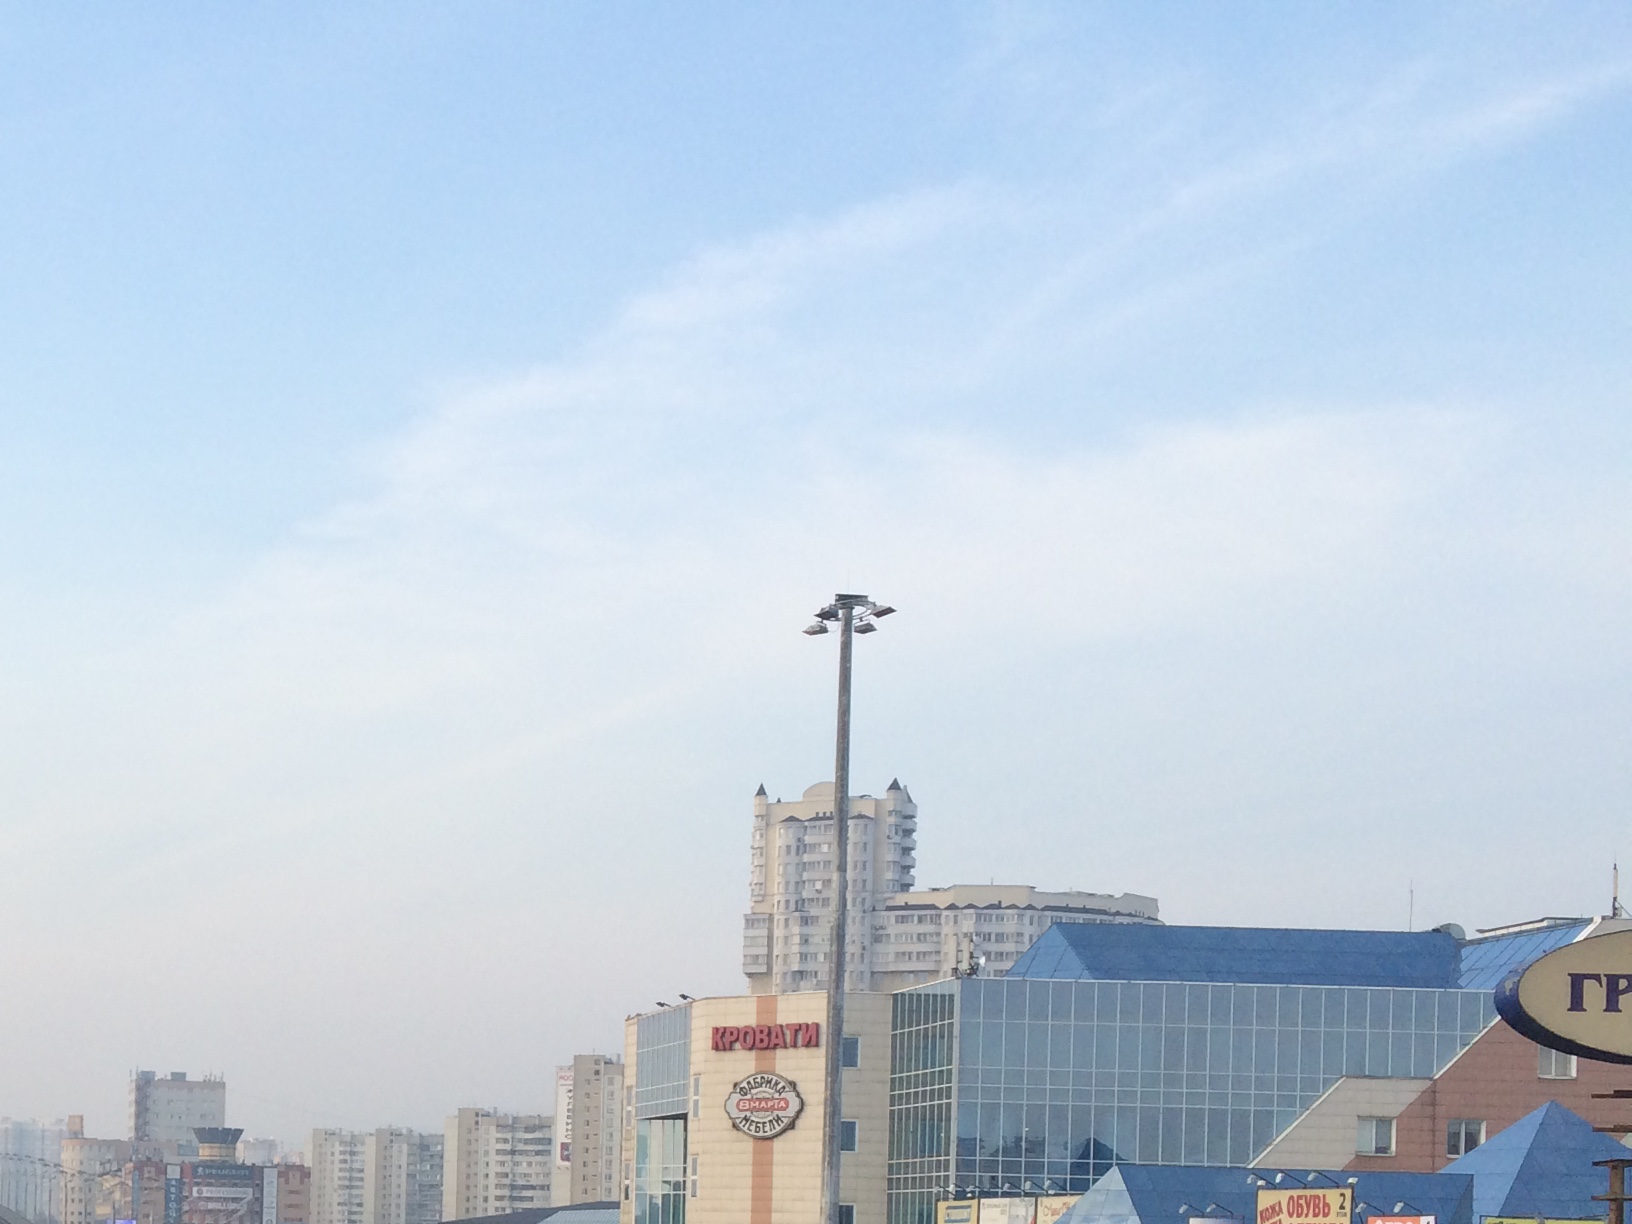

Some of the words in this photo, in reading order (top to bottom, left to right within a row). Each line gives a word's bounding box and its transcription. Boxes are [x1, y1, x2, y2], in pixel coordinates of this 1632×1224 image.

[711, 1022, 820, 1052] КРОВАТИ
[738, 1075, 787, 1097] ФАБРИКА
[739, 1100, 750, 1110] 8
[750, 1100, 787, 1109] МАРТА
[738, 1113, 785, 1134] МЕБЕЛИ
[1287, 1194, 1331, 1219] ОБУВЬ
[1338, 1192, 1346, 1211] 2
